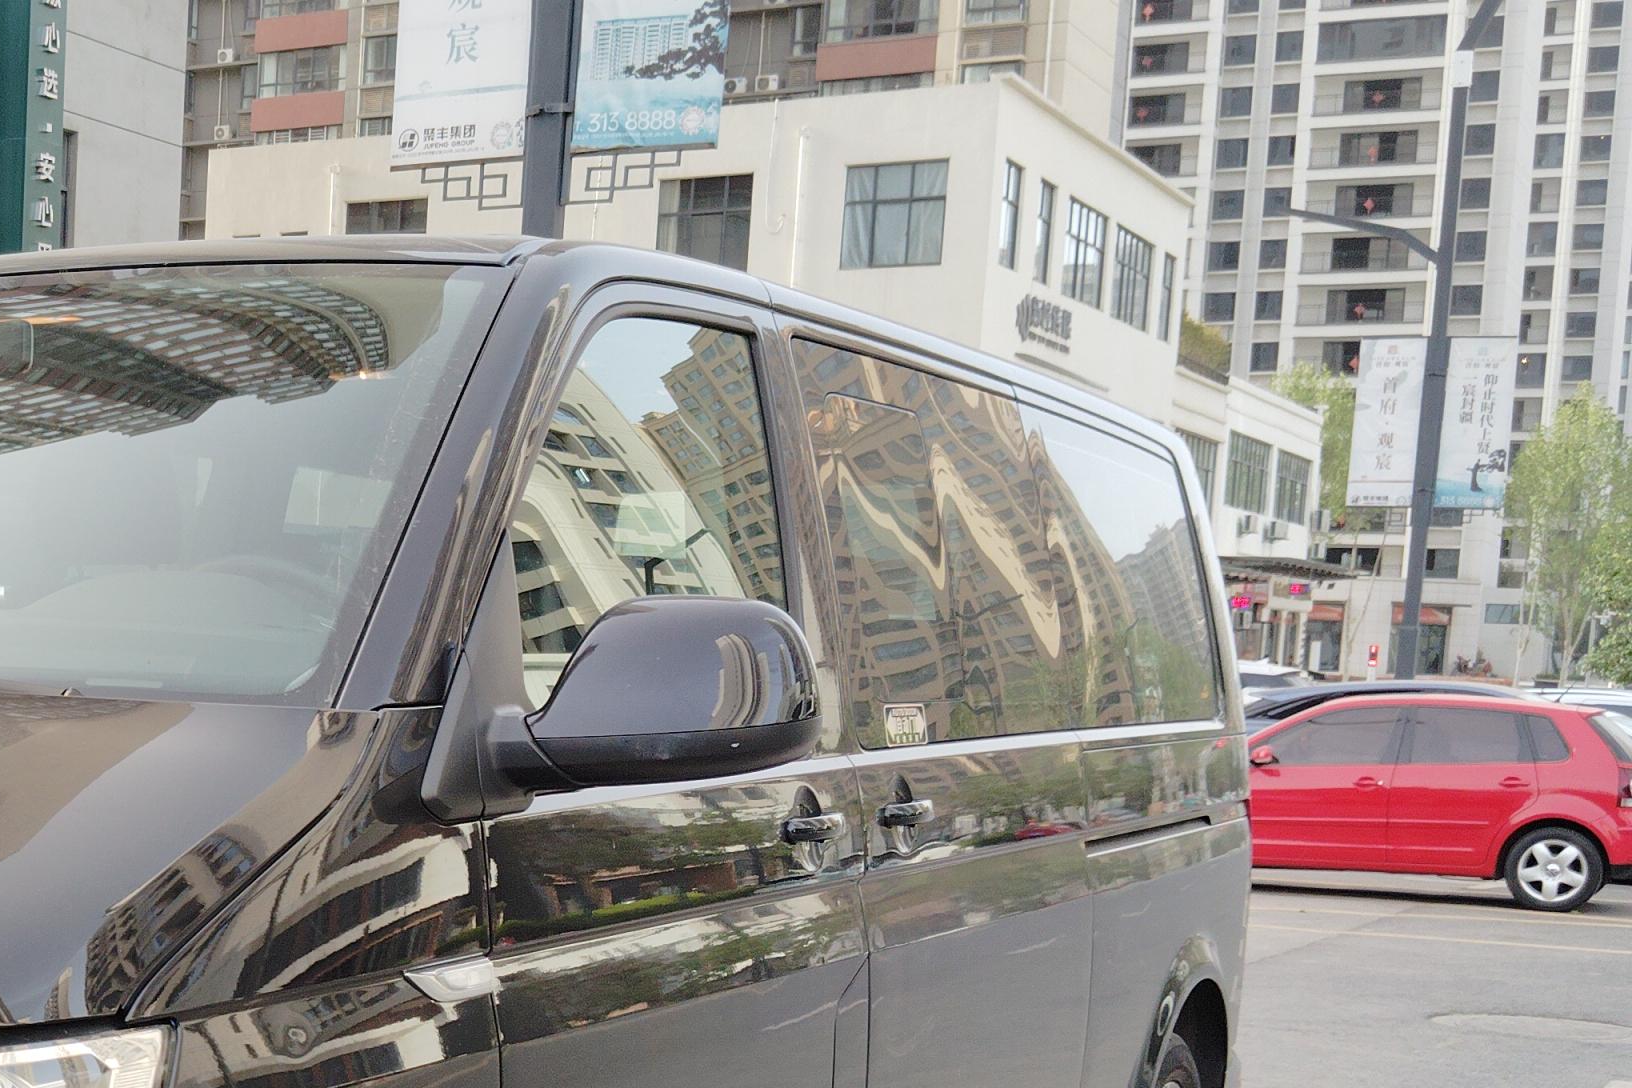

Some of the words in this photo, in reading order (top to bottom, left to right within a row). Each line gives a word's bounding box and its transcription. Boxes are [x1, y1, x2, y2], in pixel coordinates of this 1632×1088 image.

[35, 0, 61, 251] 心选·安心
[587, 111, 620, 132] 313
[625, 109, 676, 131] 8888
[423, 124, 476, 142] 聚丰集团
